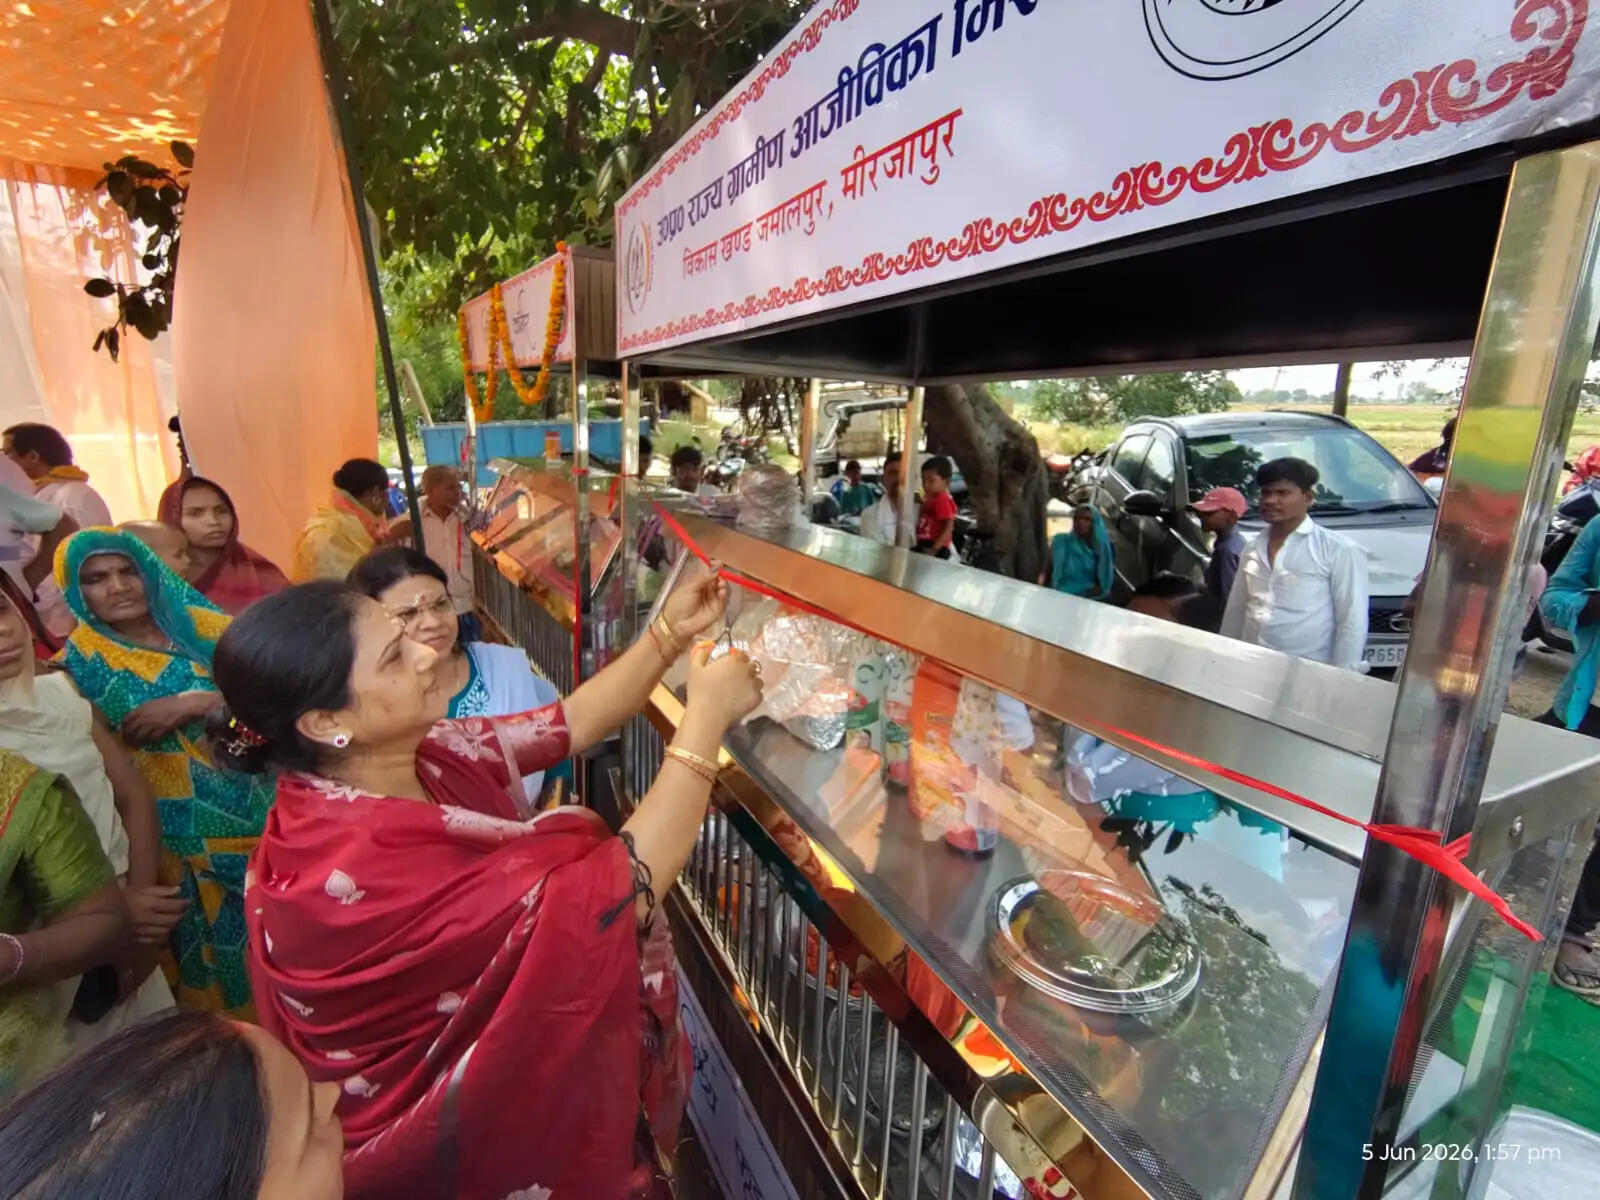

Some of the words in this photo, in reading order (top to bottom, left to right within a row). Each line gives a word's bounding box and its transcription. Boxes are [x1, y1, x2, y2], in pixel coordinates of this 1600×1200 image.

[682, 247, 718, 280] विकास
[720, 222, 753, 261] खण्ड
[756, 179, 834, 242] जमालपुर,
[841, 107, 963, 199] मीरजापुर
[688, 175, 723, 227] राज्य
[727, 128, 785, 206] ग्रामीण
[790, 12, 943, 158] आजीविका
